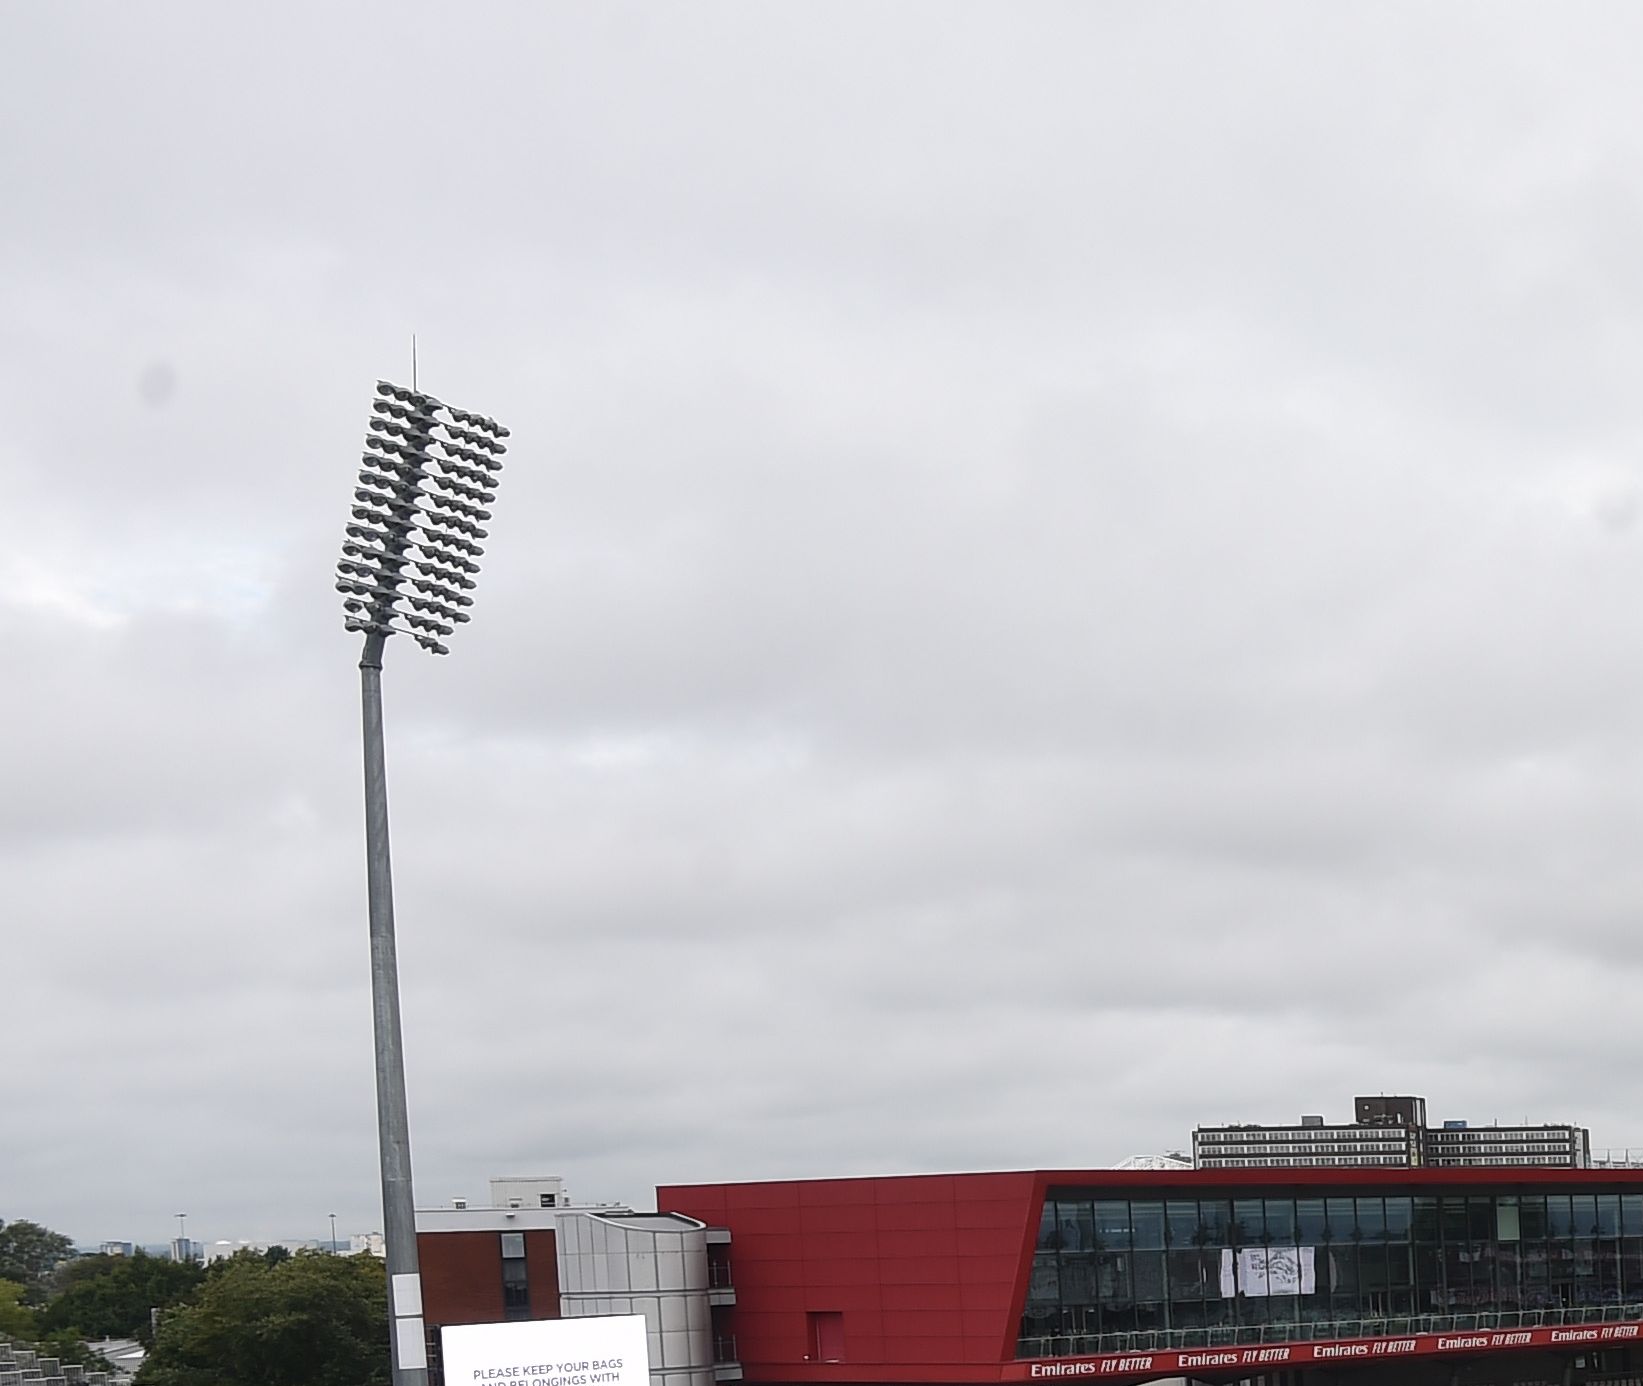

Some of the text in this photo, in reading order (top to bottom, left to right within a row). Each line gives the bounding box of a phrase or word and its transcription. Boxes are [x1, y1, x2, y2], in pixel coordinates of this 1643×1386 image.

[1438, 1333, 1532, 1350] Emirates FLY BETTER
[1551, 1326, 1639, 1342] Emirates FLY BETTER
[1178, 1348, 1290, 1367] Emirates FLY BETTER
[1313, 1340, 1416, 1358] Emirates FLY BETTER
[474, 1359, 623, 1379] PLEASE KEEP YOUR BAGS
[1031, 1357, 1152, 1378] Emirates FLY BETTER
[590, 1373, 620, 1383] WITH
